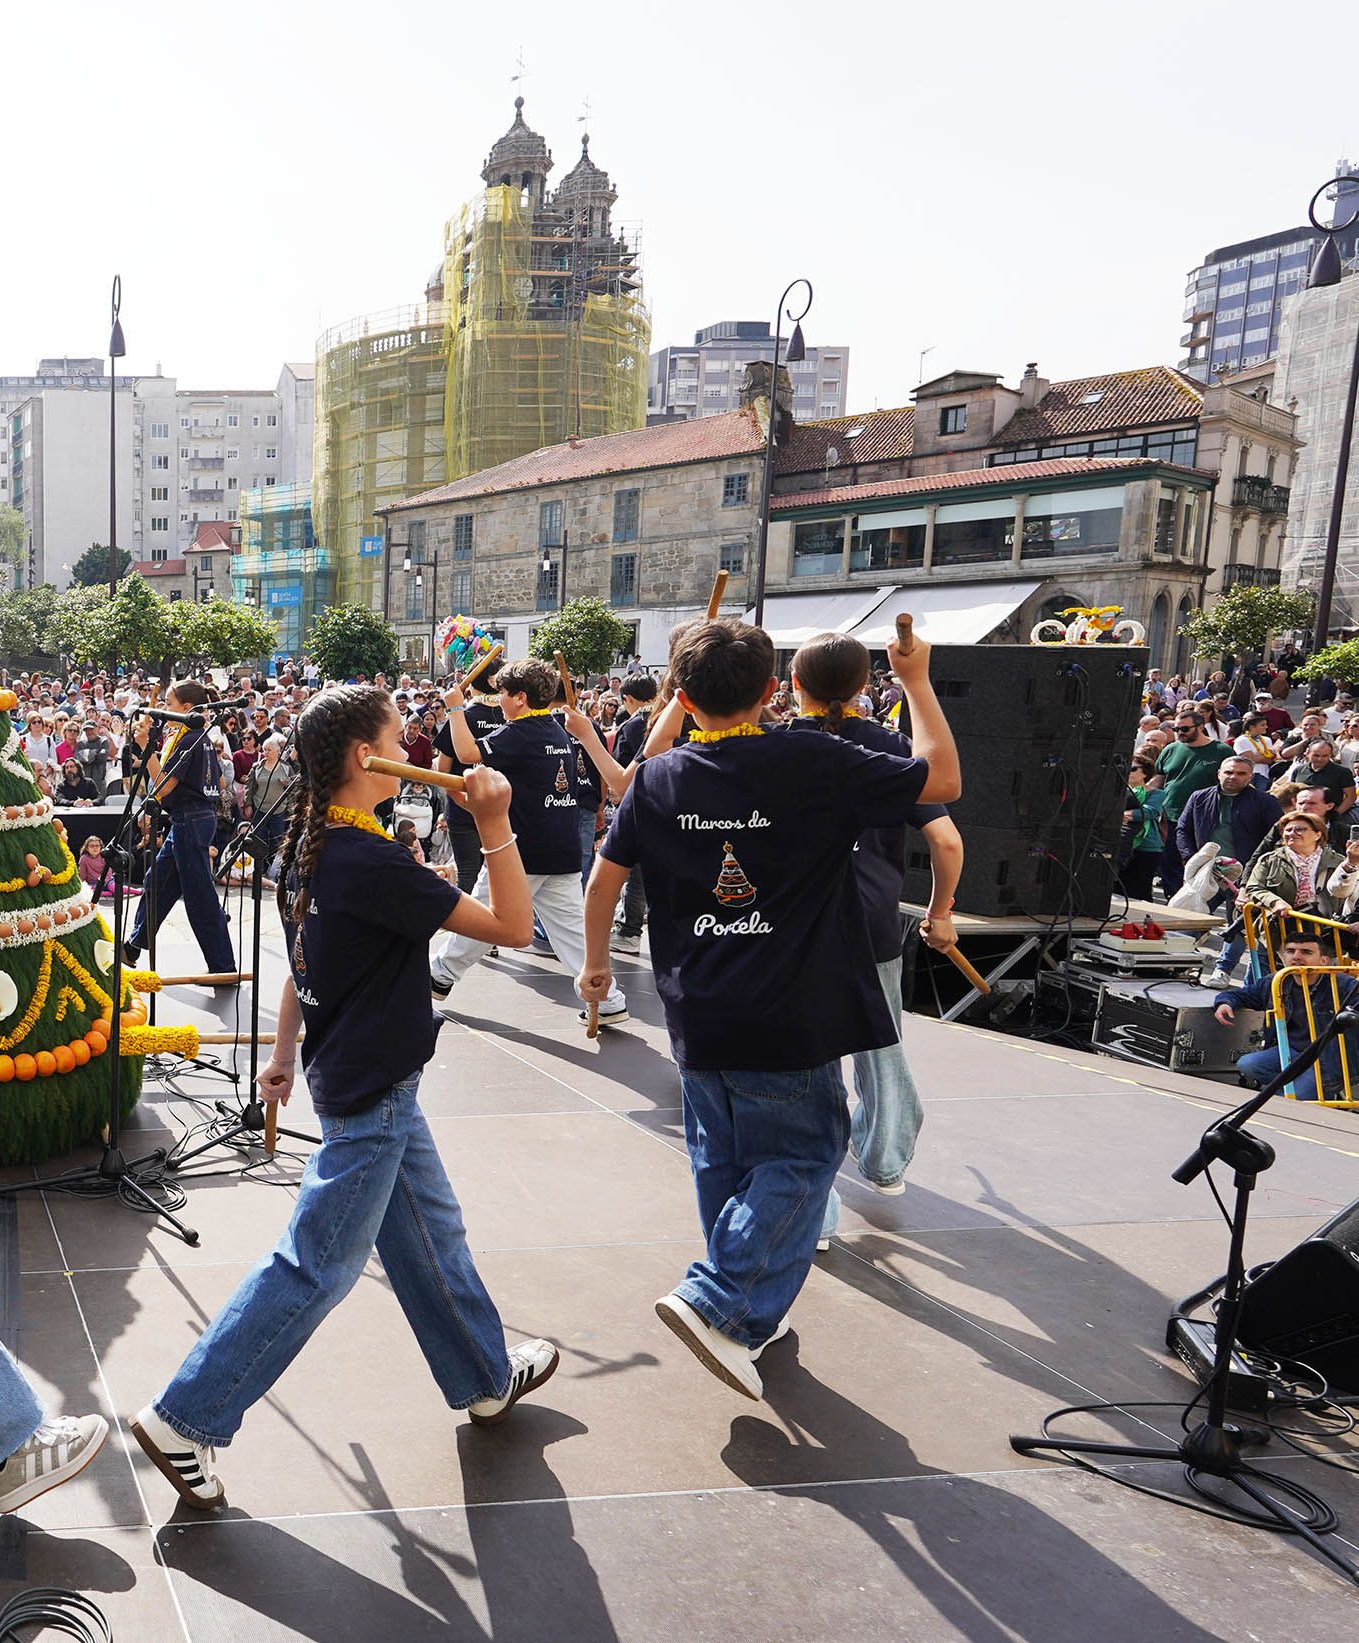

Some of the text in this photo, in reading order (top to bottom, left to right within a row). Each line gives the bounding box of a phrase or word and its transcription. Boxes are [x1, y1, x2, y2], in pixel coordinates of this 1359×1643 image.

[544, 793, 577, 808] Portela
[677, 810, 771, 830] Marcos da
[693, 911, 773, 937] Portela
